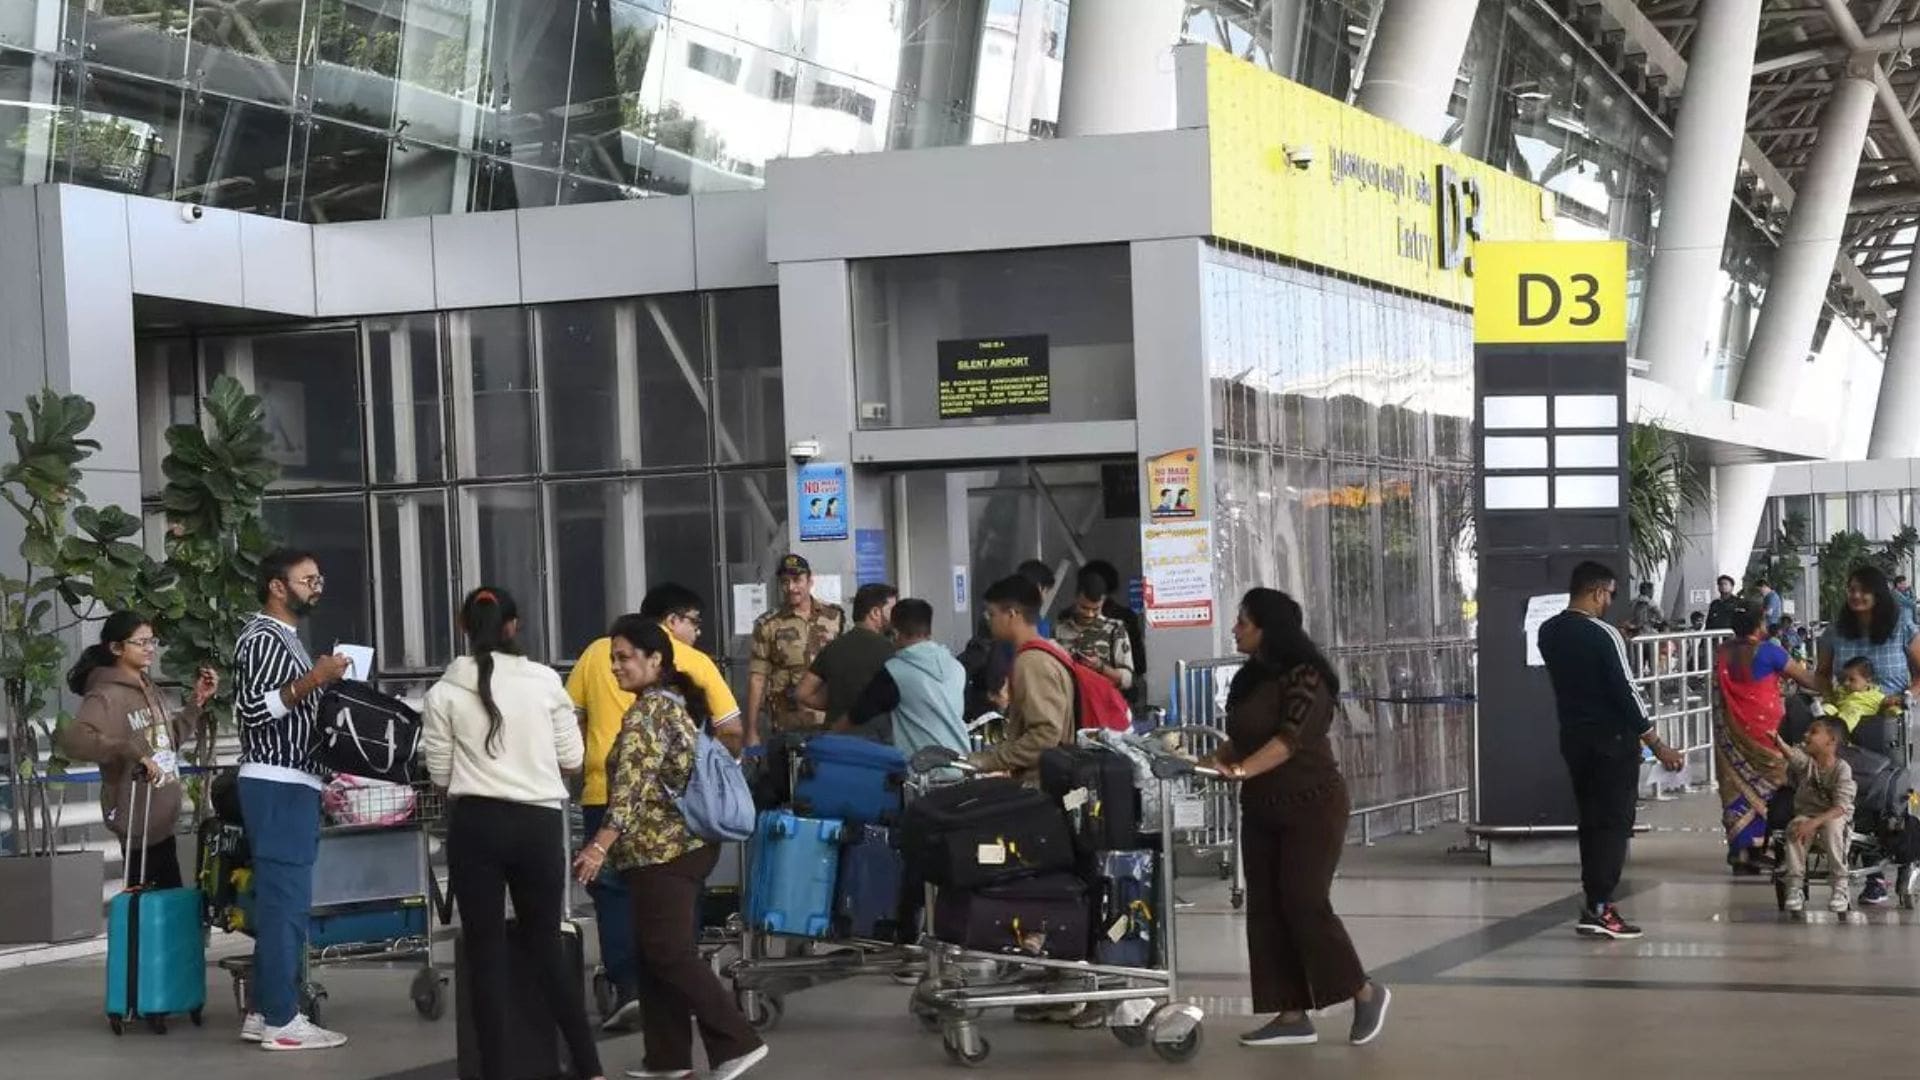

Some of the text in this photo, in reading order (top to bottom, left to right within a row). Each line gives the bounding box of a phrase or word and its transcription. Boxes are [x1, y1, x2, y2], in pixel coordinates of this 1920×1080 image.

[1436, 164, 1480, 277] D3
[1397, 216, 1432, 278] Entry
[1518, 273, 1601, 326] D3
[957, 356, 1029, 370] SILENT AIRPORT
[990, 376, 1048, 384] ANNOUNCEMENTS
[804, 481, 820, 493] NO
